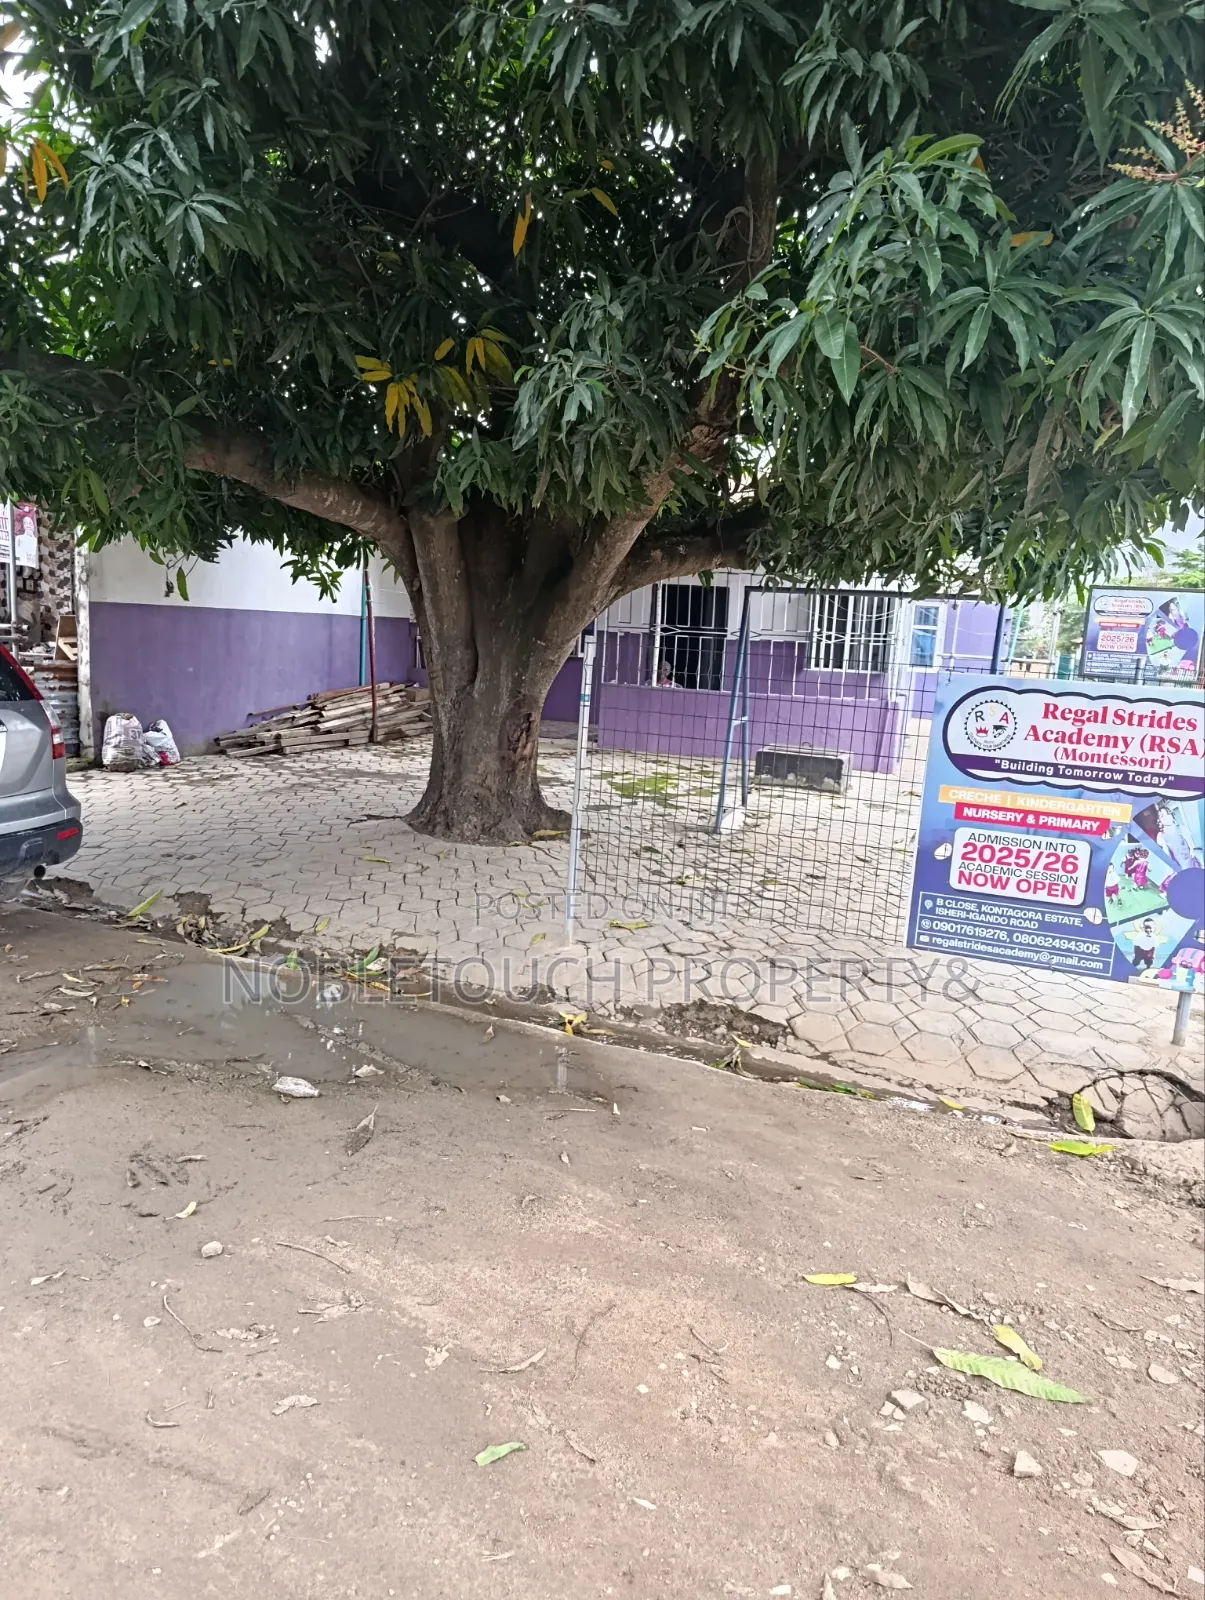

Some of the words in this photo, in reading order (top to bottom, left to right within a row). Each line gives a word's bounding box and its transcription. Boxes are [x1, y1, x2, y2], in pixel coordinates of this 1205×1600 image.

[1101, 635, 1135, 643] 2025/26
[1041, 702, 1109, 727] Regal
[1112, 708, 1198, 732] Strides
[1023, 724, 1135, 754] Academy
[994, 759, 1054, 776] "Building
[1057, 765, 1124, 781] Tomorrow
[1127, 772, 1175, 787] Today"
[1053, 746, 1172, 772] (Montessori)
[948, 789, 1002, 804] CRECHE
[1016, 796, 1122, 817] KINDERGARTEN
[962, 807, 1024, 823] NURSERY
[1025, 813, 1036, 824] &
[1038, 815, 1100, 831] PRIMARY
[968, 832, 1042, 850] ADMISSION
[1045, 840, 1077, 854] INTO
[960, 842, 1079, 874] 2025/26
[957, 871, 1011, 891] NOW
[1015, 878, 1077, 900] OPEN
[958, 861, 1023, 878] ACADEMIC
[1025, 869, 1078, 885] SESSION
[935, 907, 1008, 925] ISHERI-IGANDO
[1009, 917, 1039, 930] ROAD
[936, 898, 945, 907] B
[945, 899, 979, 913] CLOSE,
[981, 903, 1042, 921] KONTAGORA
[1044, 913, 1084, 928] ESTATE,
[932, 920, 1010, 943] 09017619276,
[1012, 932, 1101, 955] 08062494305
[932, 935, 1103, 970] regalstridesacademy@gmail.com
